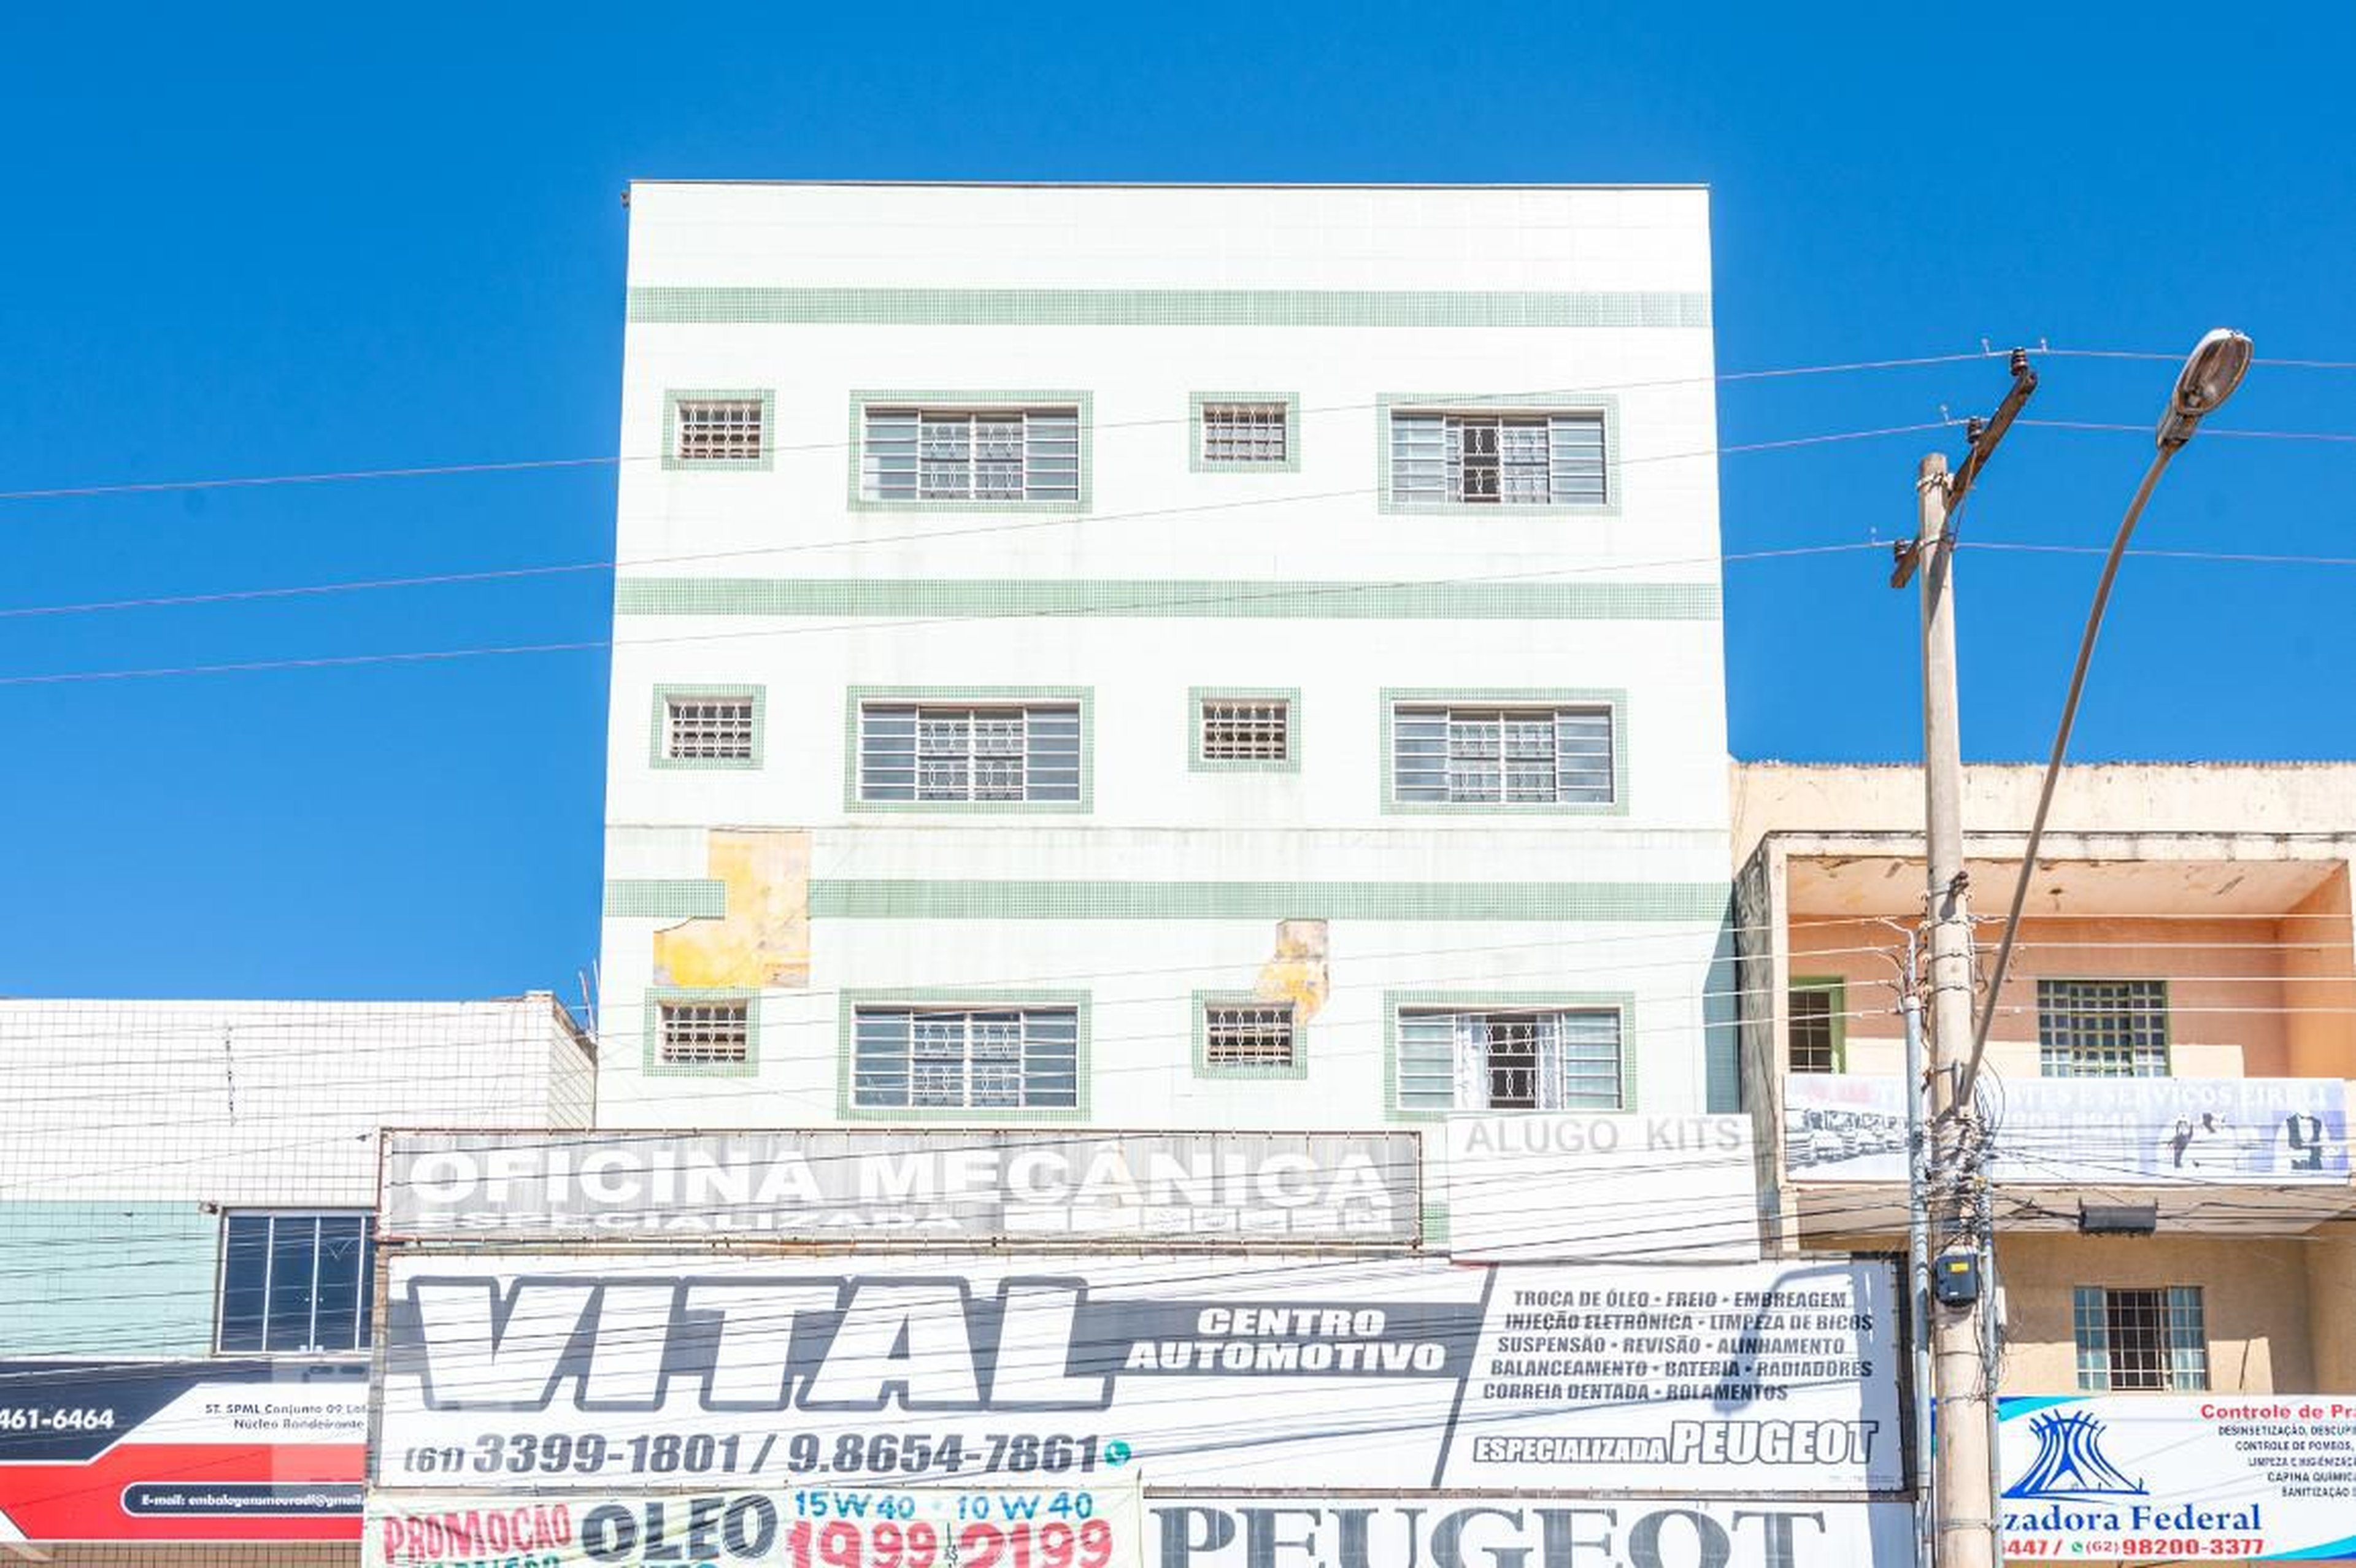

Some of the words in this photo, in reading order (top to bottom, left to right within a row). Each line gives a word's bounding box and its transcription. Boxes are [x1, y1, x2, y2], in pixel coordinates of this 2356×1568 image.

[1465, 1118, 1619, 1153] ALUGO
[1647, 1118, 1742, 1151] KITS
[409, 1149, 821, 1205] OFICINA
[861, 1142, 1393, 1205] MECÂNICA
[1514, 1290, 1574, 1307] TROCA
[1579, 1290, 1601, 1307] DE
[1606, 1287, 1650, 1308] ÓLEO
[1665, 1291, 1717, 1308] FREIO
[1733, 1291, 1847, 1309] EMBREAGEM
[1196, 1307, 1385, 1337] CENTRO
[1504, 1309, 1580, 1332] INJEÇÃO
[1584, 1310, 1693, 1331] ELETRÔNICA
[1709, 1313, 1786, 1331] LIMPEZA
[1788, 1314, 1812, 1331] DE
[1815, 1314, 1874, 1332] BICOS
[407, 1275, 1114, 1412] VITAL
[1497, 1334, 1606, 1353] SUSPENSÃO
[1622, 1334, 1701, 1354] REVISÃO
[1717, 1337, 1846, 1355] ALINHAMENTO
[1123, 1342, 1447, 1371] AUTOMOTIVO
[1490, 1359, 1648, 1377] BALANCEAMENTO
[1665, 1361, 1740, 1377] BATERIA
[1756, 1361, 1874, 1377] RADIADORES
[1482, 1383, 1563, 1400] CORREIA
[1567, 1383, 1650, 1400] DENTADA
[1665, 1384, 1789, 1401] ROLAMENTOS
[0, 1408, 115, 1430] 461-6464
[226, 1404, 261, 1415] SPML
[264, 1404, 323, 1416] Conjunto
[326, 1404, 344, 1415] 09
[2200, 1404, 2292, 1420] Controle
[2298, 1404, 2324, 1420] de
[2331, 1404, 2356, 1418] Pr
[233, 1418, 279, 1430] Núcleo
[283, 1419, 365, 1431] Bandeirante
[403, 1447, 465, 1473] (61)
[472, 1433, 741, 1473] 3399-1801
[748, 1433, 778, 1474] /
[787, 1433, 1099, 1473] 9.8654-7861
[1472, 1436, 1668, 1464] ESPECIALIZADA
[1669, 1420, 1879, 1465] PEUGEOT
[2235, 1440, 2289, 1451] CONTROLE
[2292, 1440, 2305, 1451] DE
[2248, 1456, 2289, 1467] LIMPEZA
[2267, 1472, 2310, 1482] CAPINA
[141, 1495, 185, 1505] E-mail:
[2132, 1502, 2262, 1531] Federal
[1149, 1506, 1827, 1568] PEUGEOT
[2001, 1538, 2048, 1556] 447
[2085, 1540, 2120, 1556] (62)
[2122, 1538, 2264, 1556] 98200-3377
